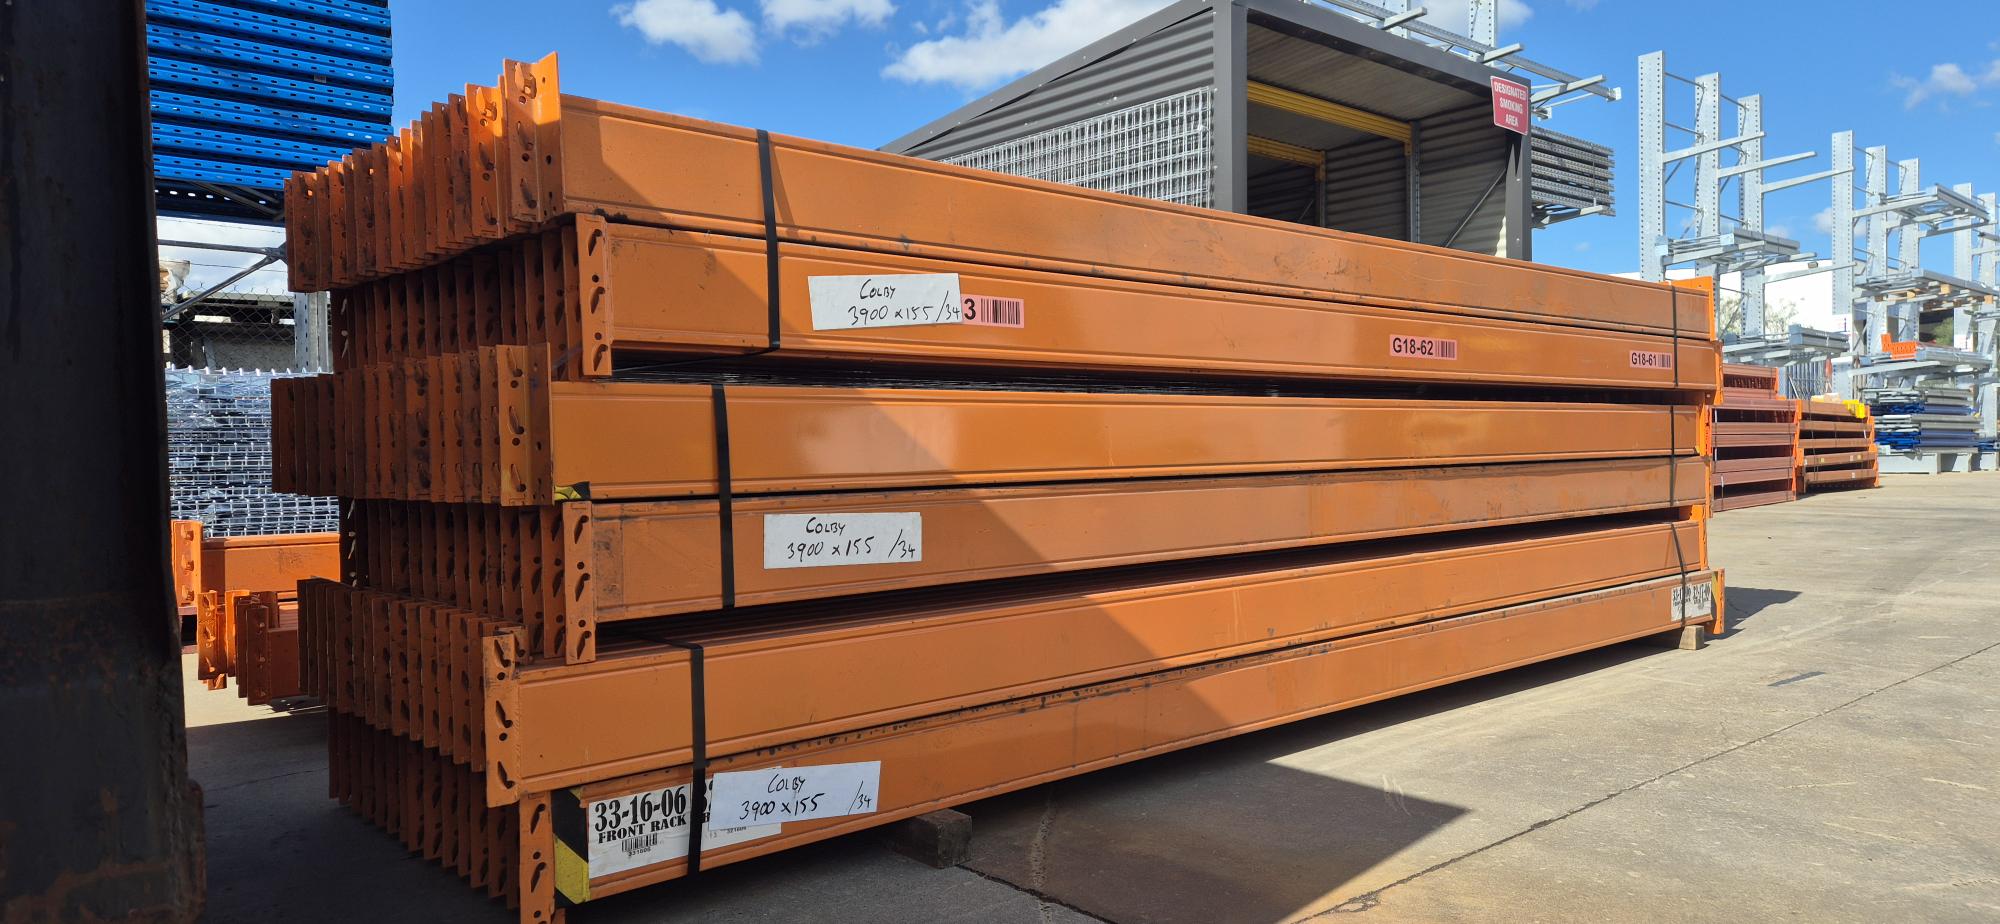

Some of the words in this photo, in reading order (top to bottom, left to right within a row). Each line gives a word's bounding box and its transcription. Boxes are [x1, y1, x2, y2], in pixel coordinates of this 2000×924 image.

[1494, 82, 1526, 100] DESIGNATED
[1500, 97, 1522, 114] SMOKING
[1506, 114, 1518, 127] AREA
[859, 278, 896, 300] COLBY
[847, 305, 889, 326] 3900
[964, 298, 976, 321] 3
[1392, 337, 1434, 356] G18-62
[1631, 352, 1657, 367] G18-61
[805, 516, 846, 536] COLBY
[787, 541, 824, 562] 3900
[767, 773, 806, 795] COLBY
[594, 786, 687, 832] 33-16-06
[739, 800, 776, 821] 3900
[598, 823, 646, 844] FRONT
[650, 814, 687, 833] RACK
